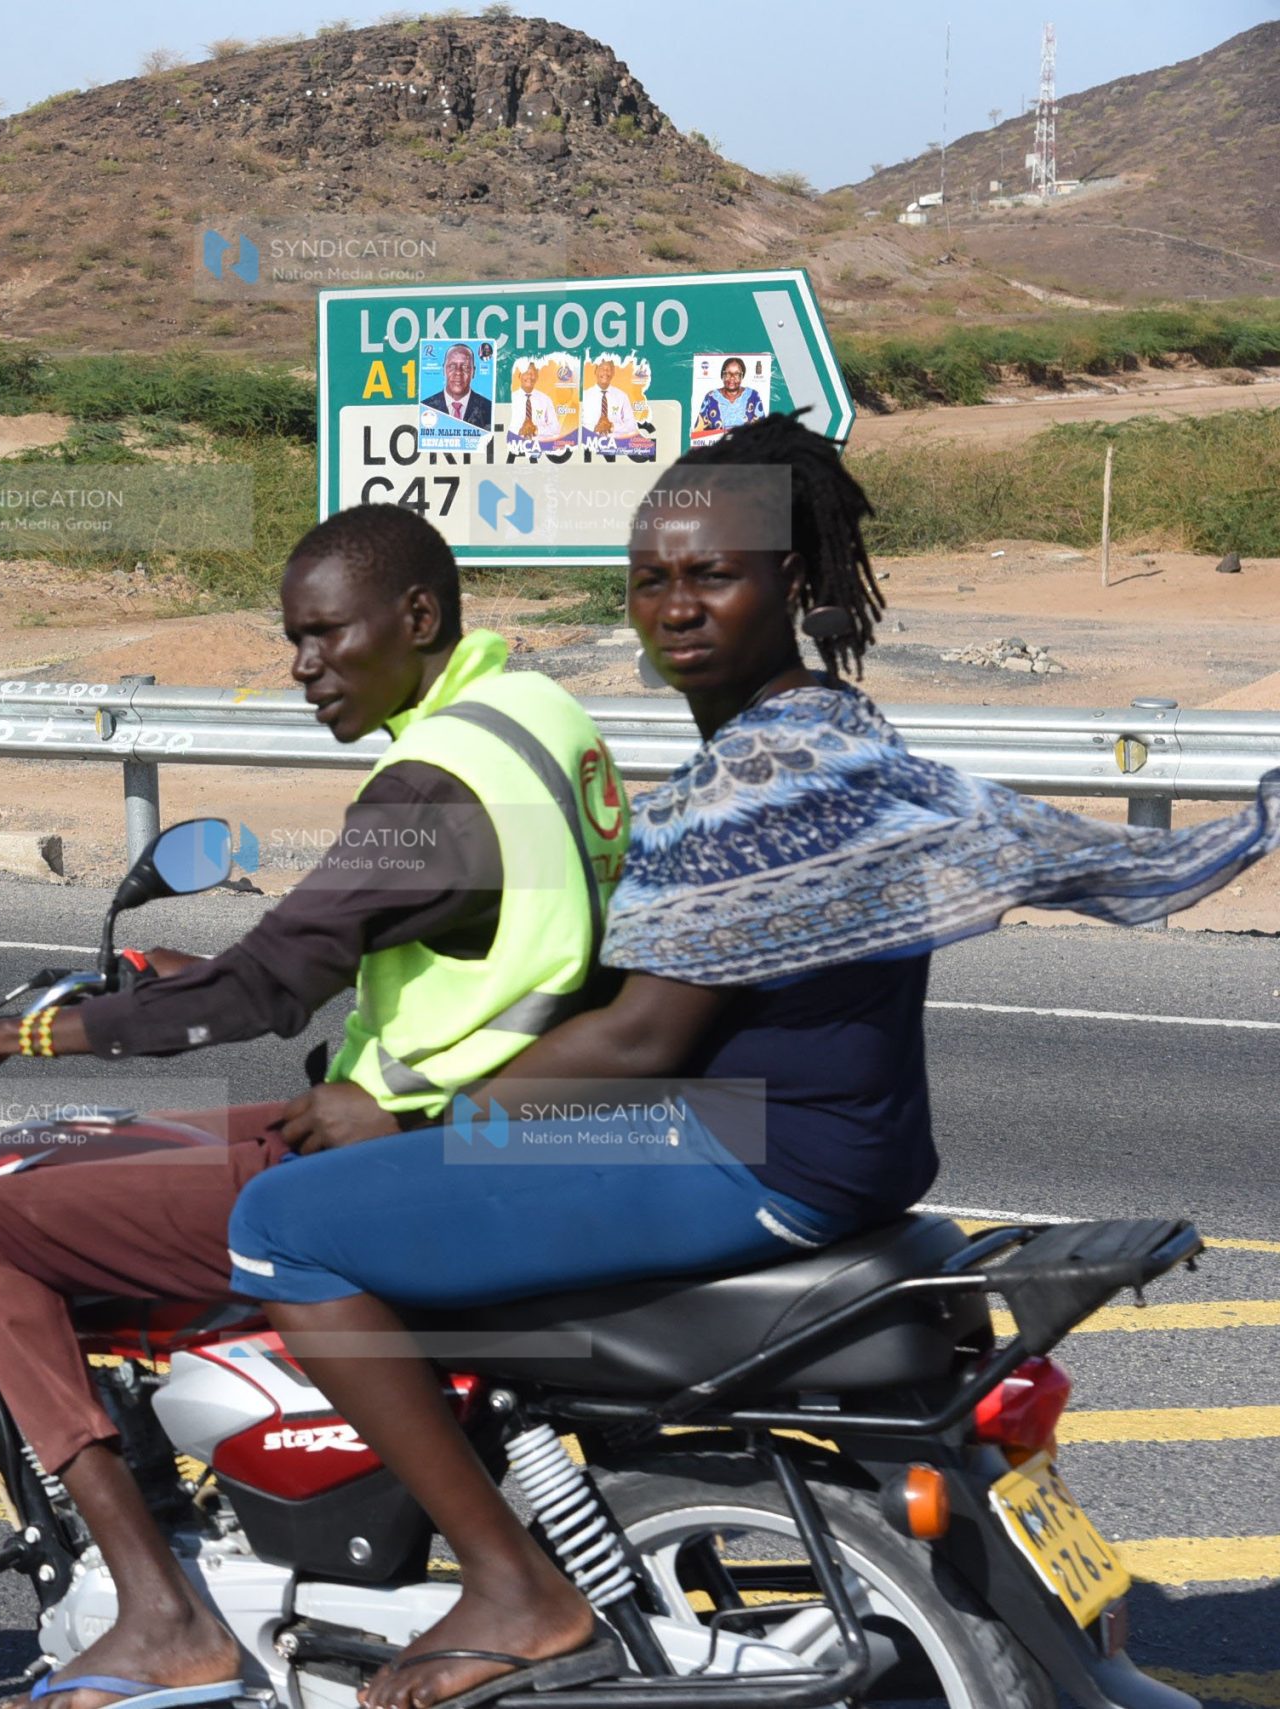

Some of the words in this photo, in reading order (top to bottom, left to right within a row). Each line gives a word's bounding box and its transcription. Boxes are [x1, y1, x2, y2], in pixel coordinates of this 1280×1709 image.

[360, 299, 689, 353] LOKICHOGIO
[362, 359, 416, 399] A1
[586, 437, 617, 449] MCA
[361, 476, 460, 517] C47
